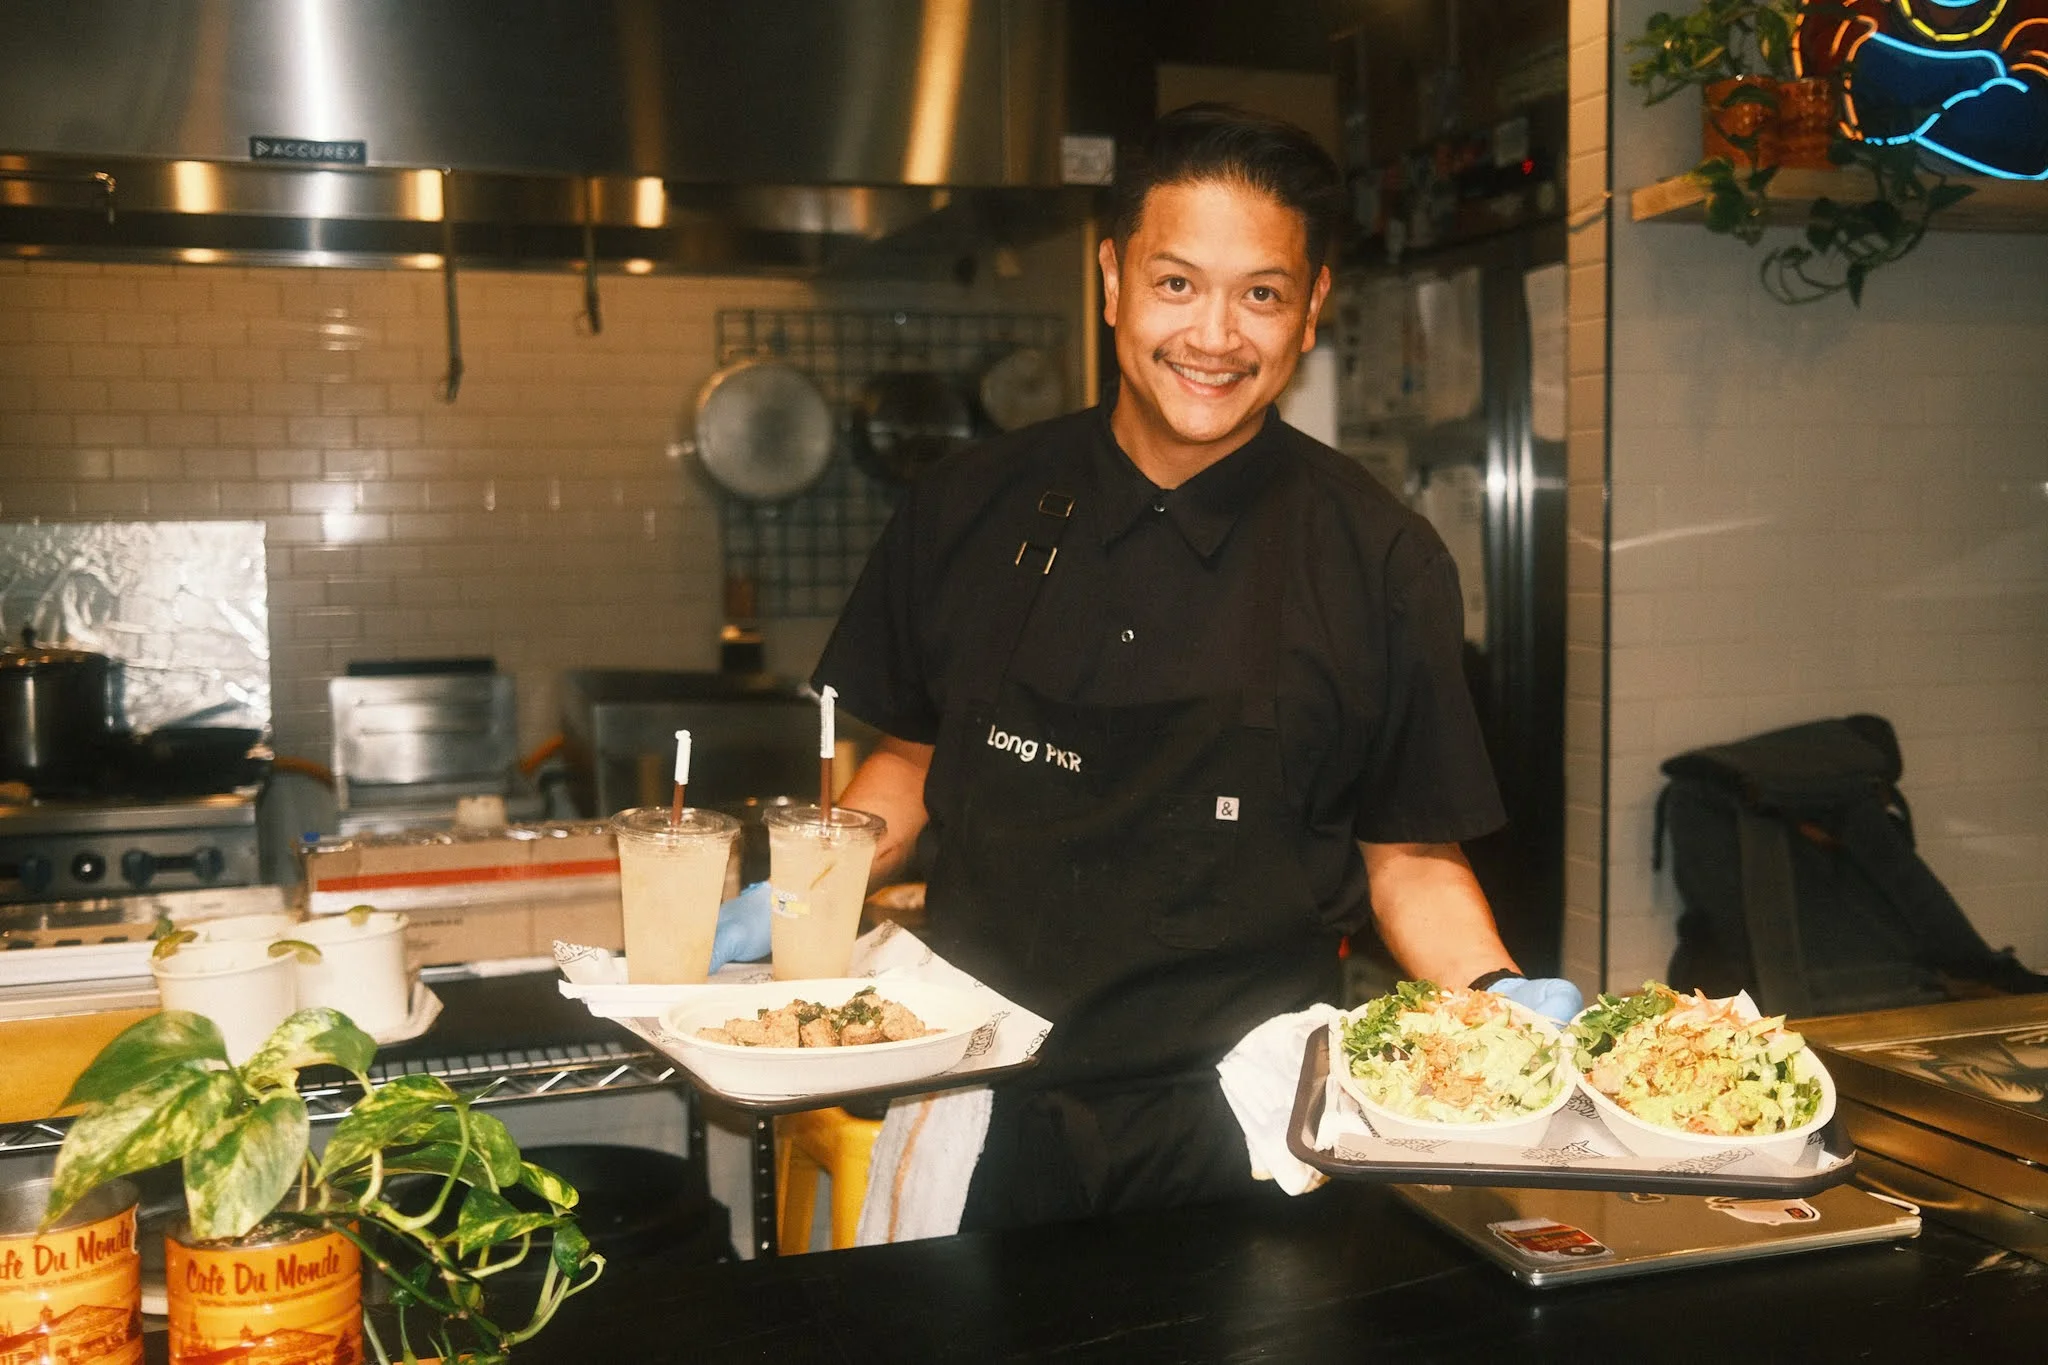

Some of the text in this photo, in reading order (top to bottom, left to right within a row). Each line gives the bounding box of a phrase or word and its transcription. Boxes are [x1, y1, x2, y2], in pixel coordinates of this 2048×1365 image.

[271, 143, 358, 159] ACCUREX
[1046, 743, 1082, 773] PKR
[1221, 801, 1233, 817] &
[33, 1244, 69, 1276] Du
[76, 1221, 131, 1270] Monde
[233, 1262, 268, 1295] Du
[275, 1246, 341, 1292] Monde
